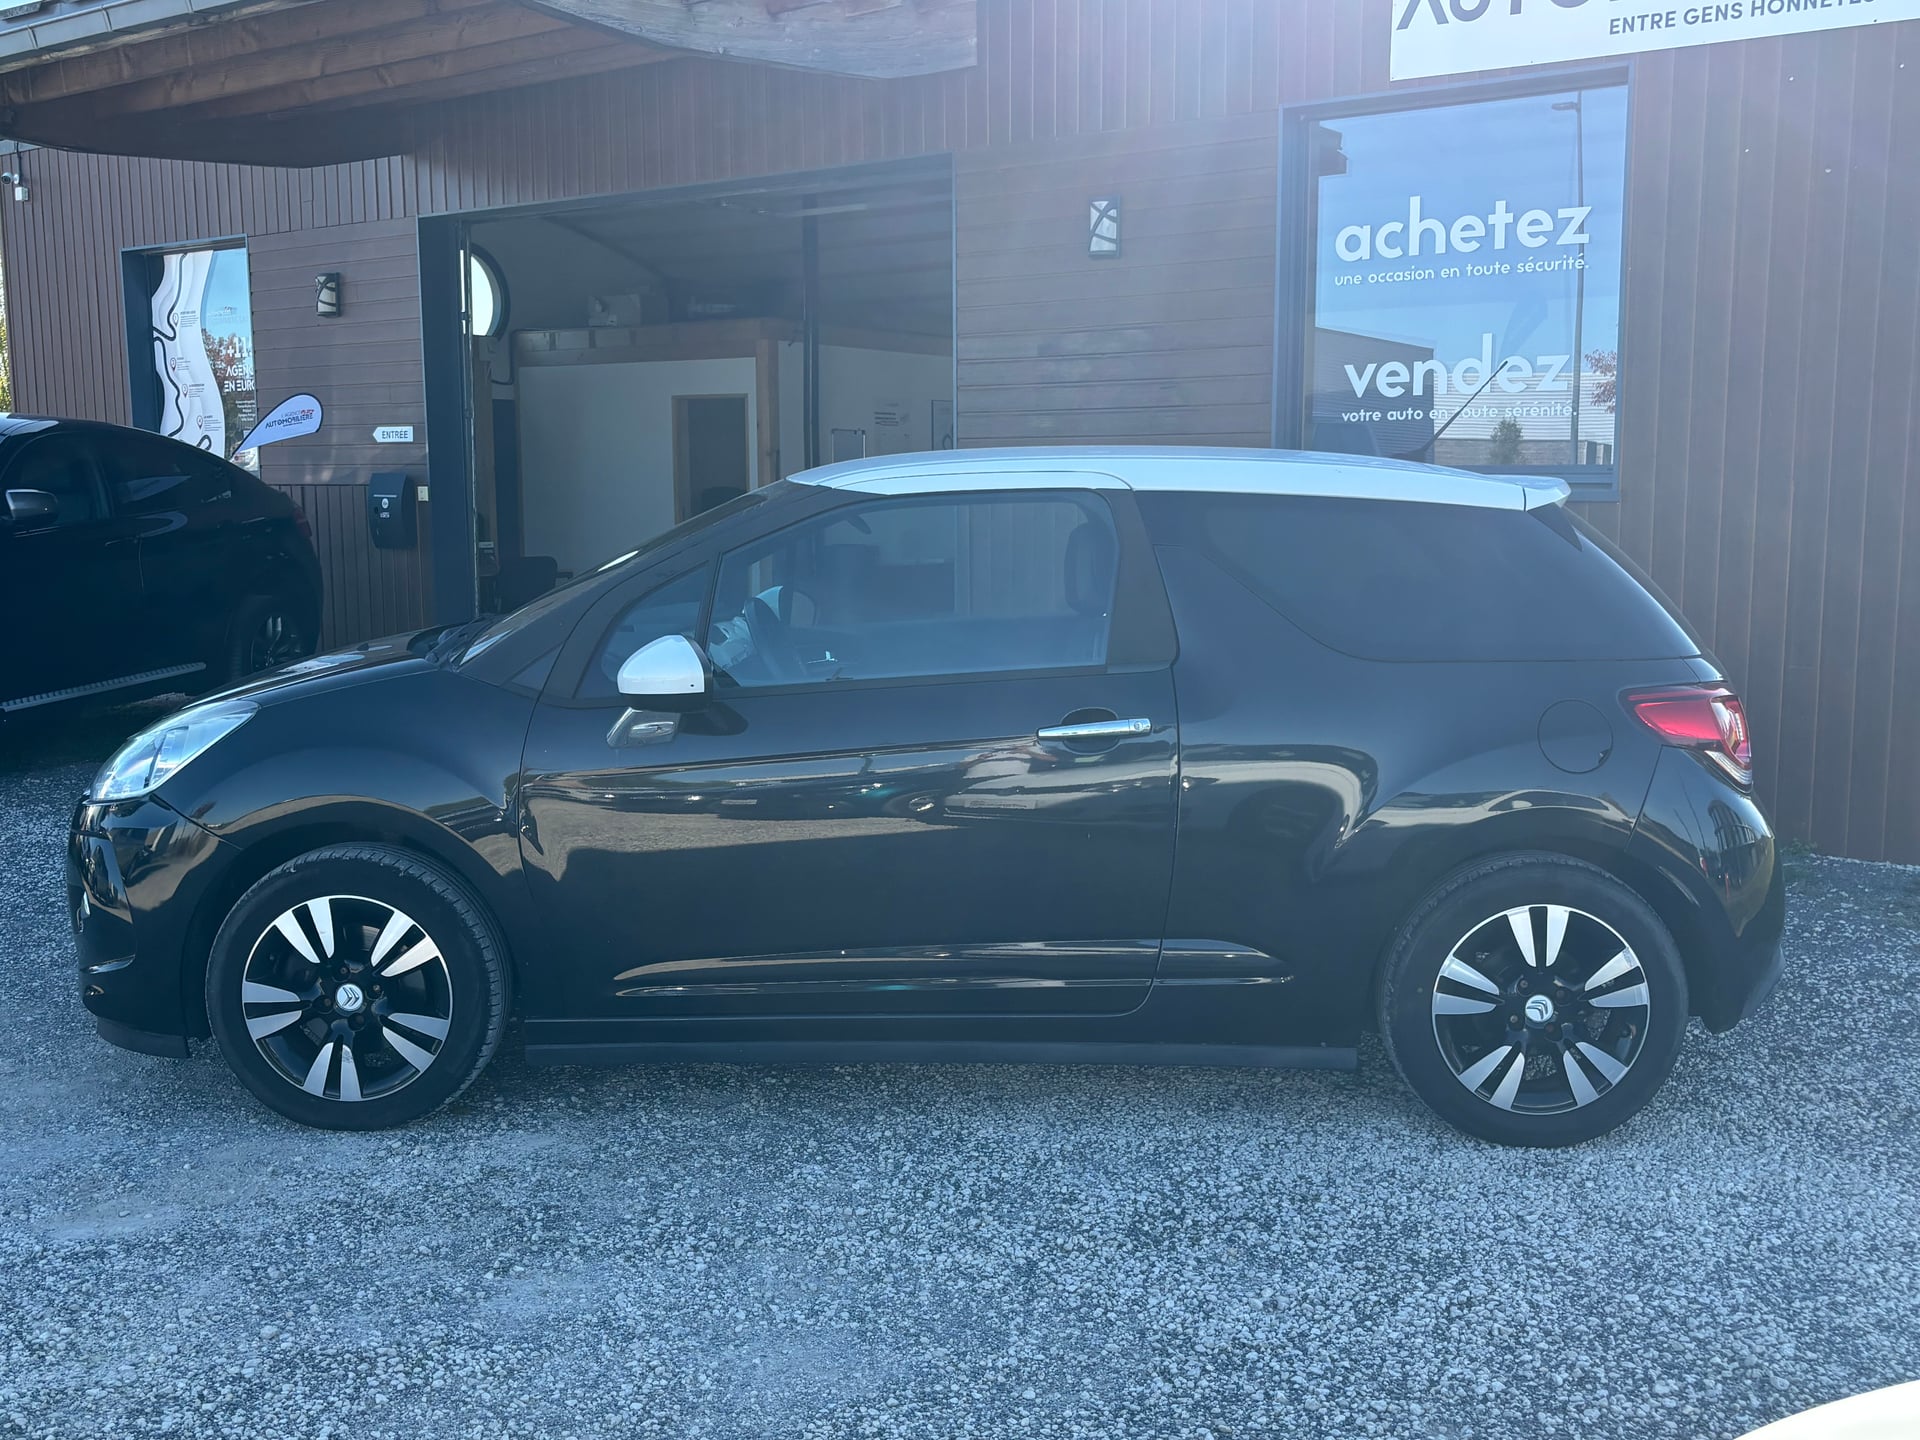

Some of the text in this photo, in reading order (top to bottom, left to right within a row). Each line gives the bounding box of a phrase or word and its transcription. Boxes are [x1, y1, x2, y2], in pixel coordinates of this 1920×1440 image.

[1609, 10, 1677, 35] ENTRE
[1683, 2, 1743, 25] GENS
[1751, 0, 1875, 17] HONN
[1335, 195, 1592, 262] achetez
[1335, 253, 1589, 286] une occasion en toute sécurité.
[1344, 332, 1570, 399] vendez
[1342, 408, 1381, 423] votre
[1387, 406, 1424, 421] auto
[1429, 408, 1448, 420] en
[1505, 400, 1577, 419] sérénité.
